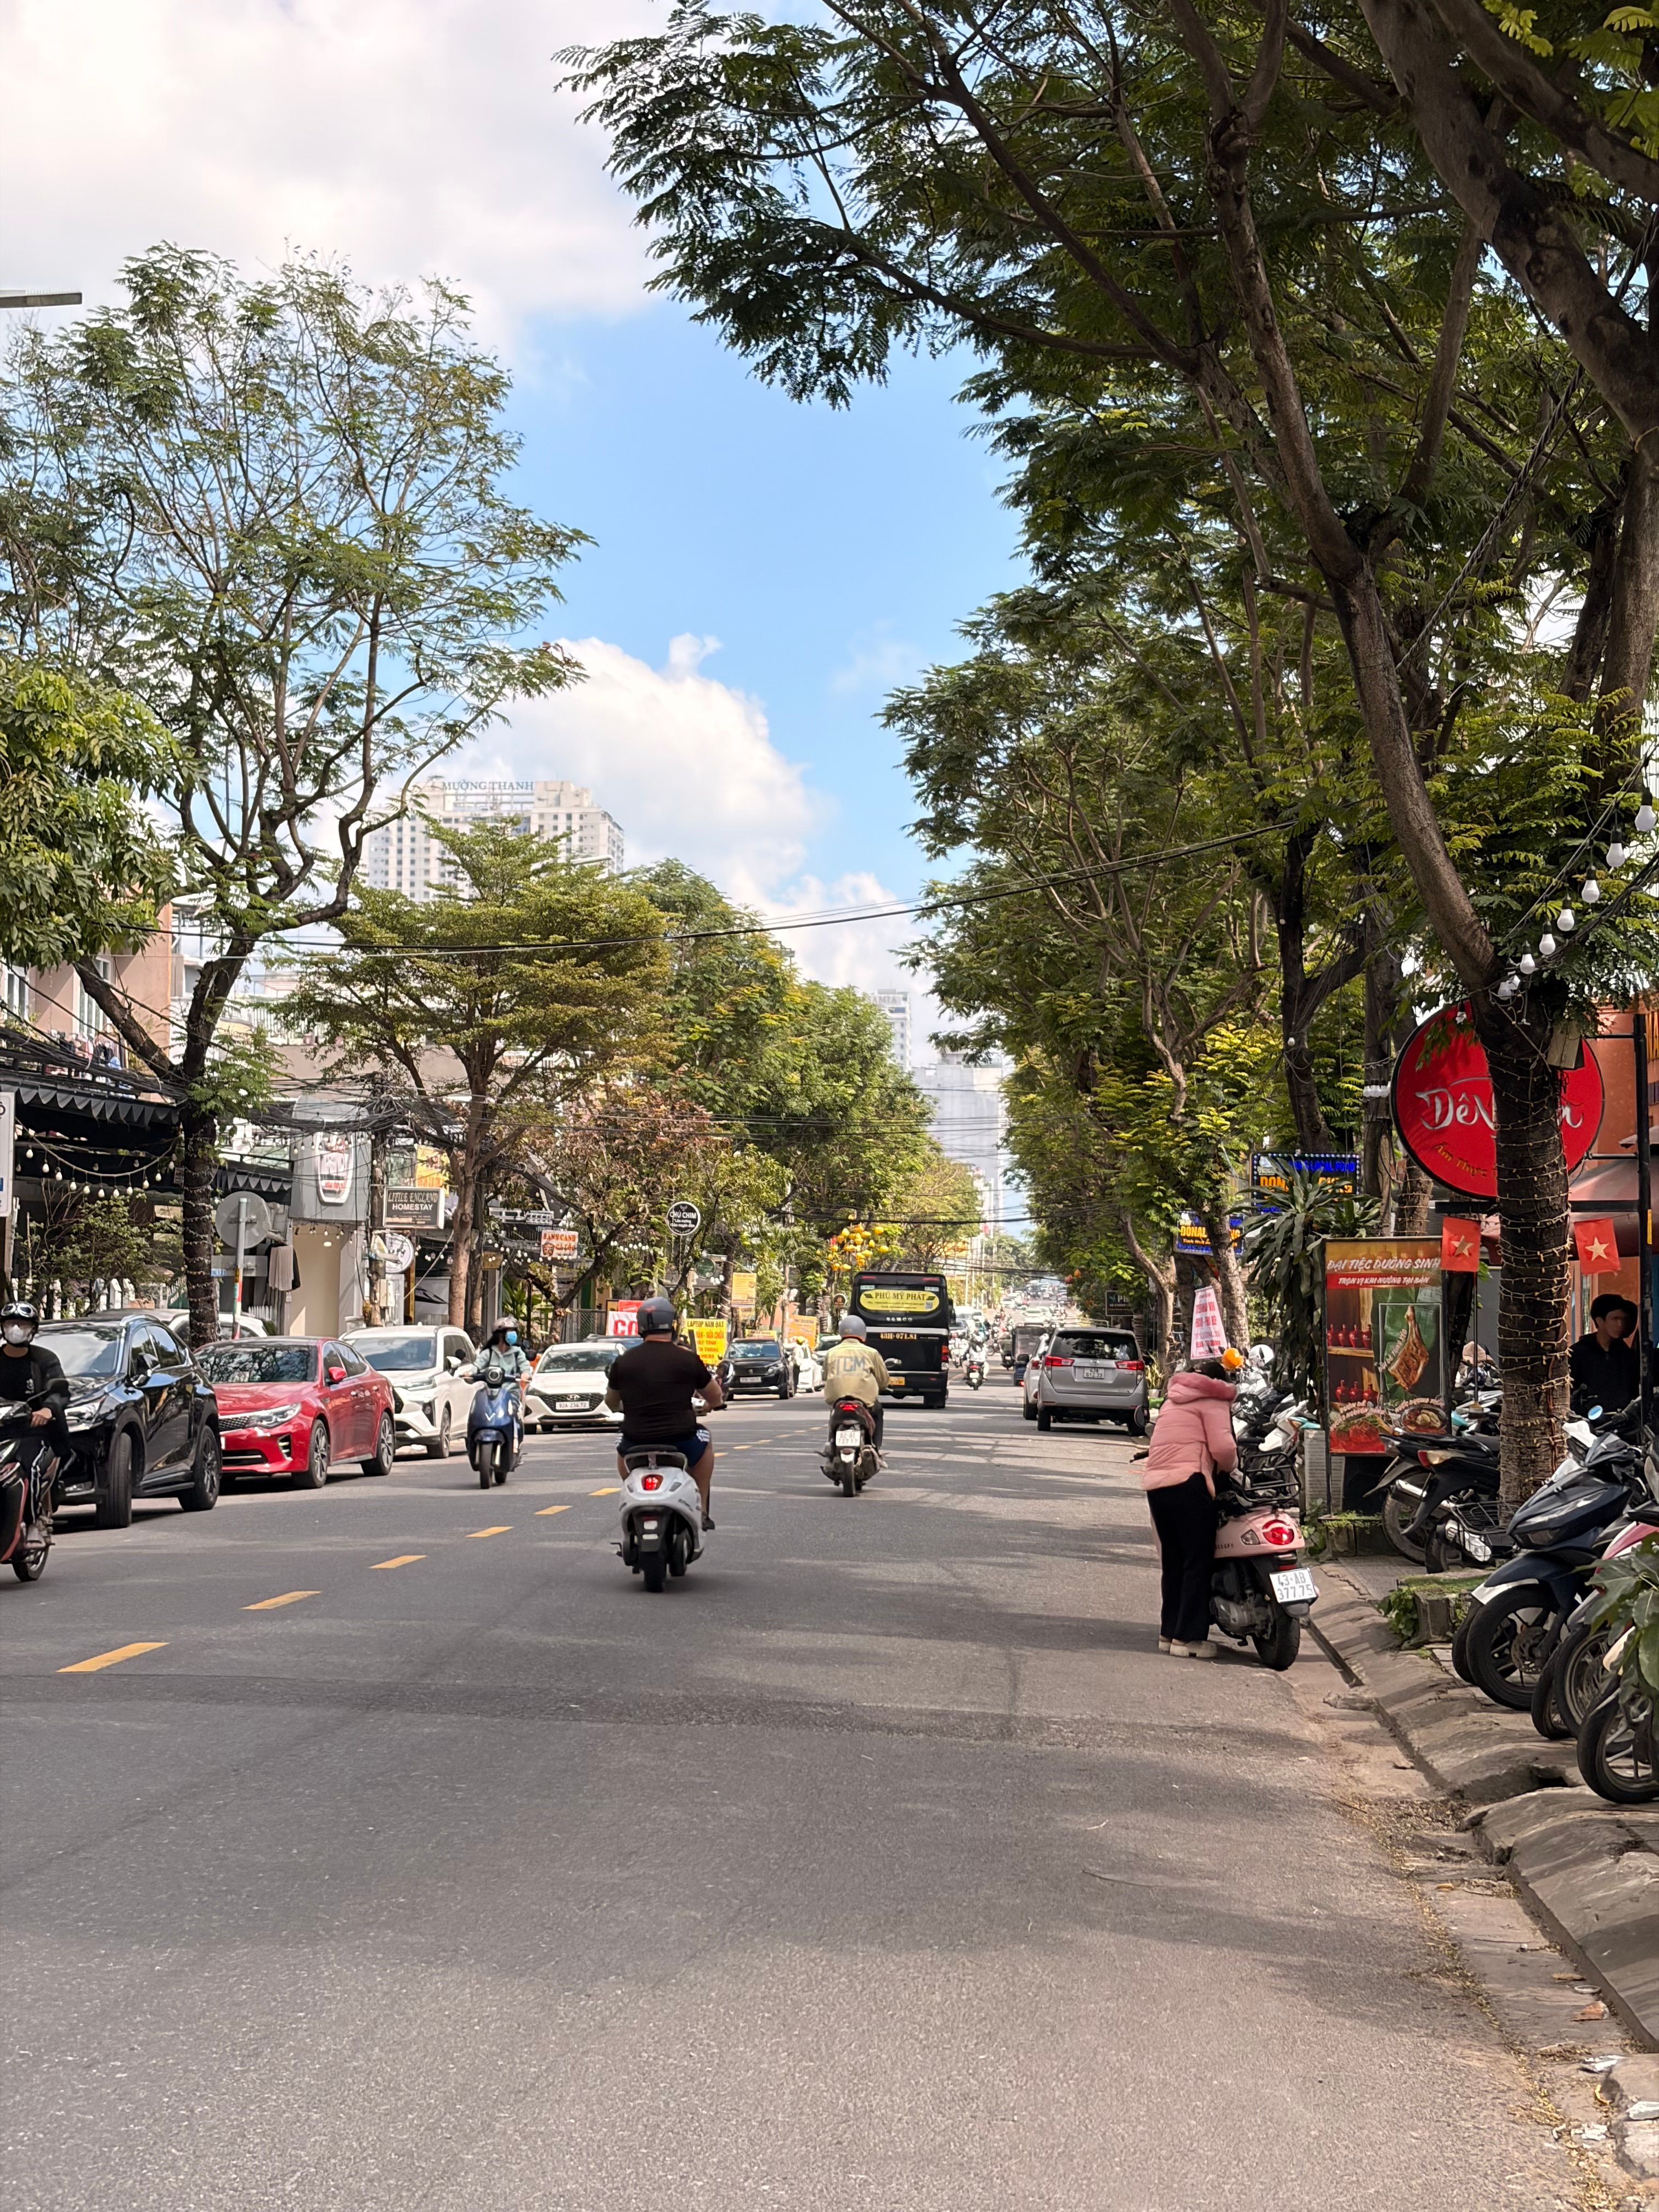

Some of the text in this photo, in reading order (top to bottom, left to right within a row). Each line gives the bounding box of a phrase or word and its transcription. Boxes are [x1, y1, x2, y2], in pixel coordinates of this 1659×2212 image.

[490, 781, 533, 790] THANH
[1327, 1260, 1346, 1272] ĐẠI
[1348, 1257, 1373, 1273] TIỆC
[1413, 1257, 1442, 1269] SINH
